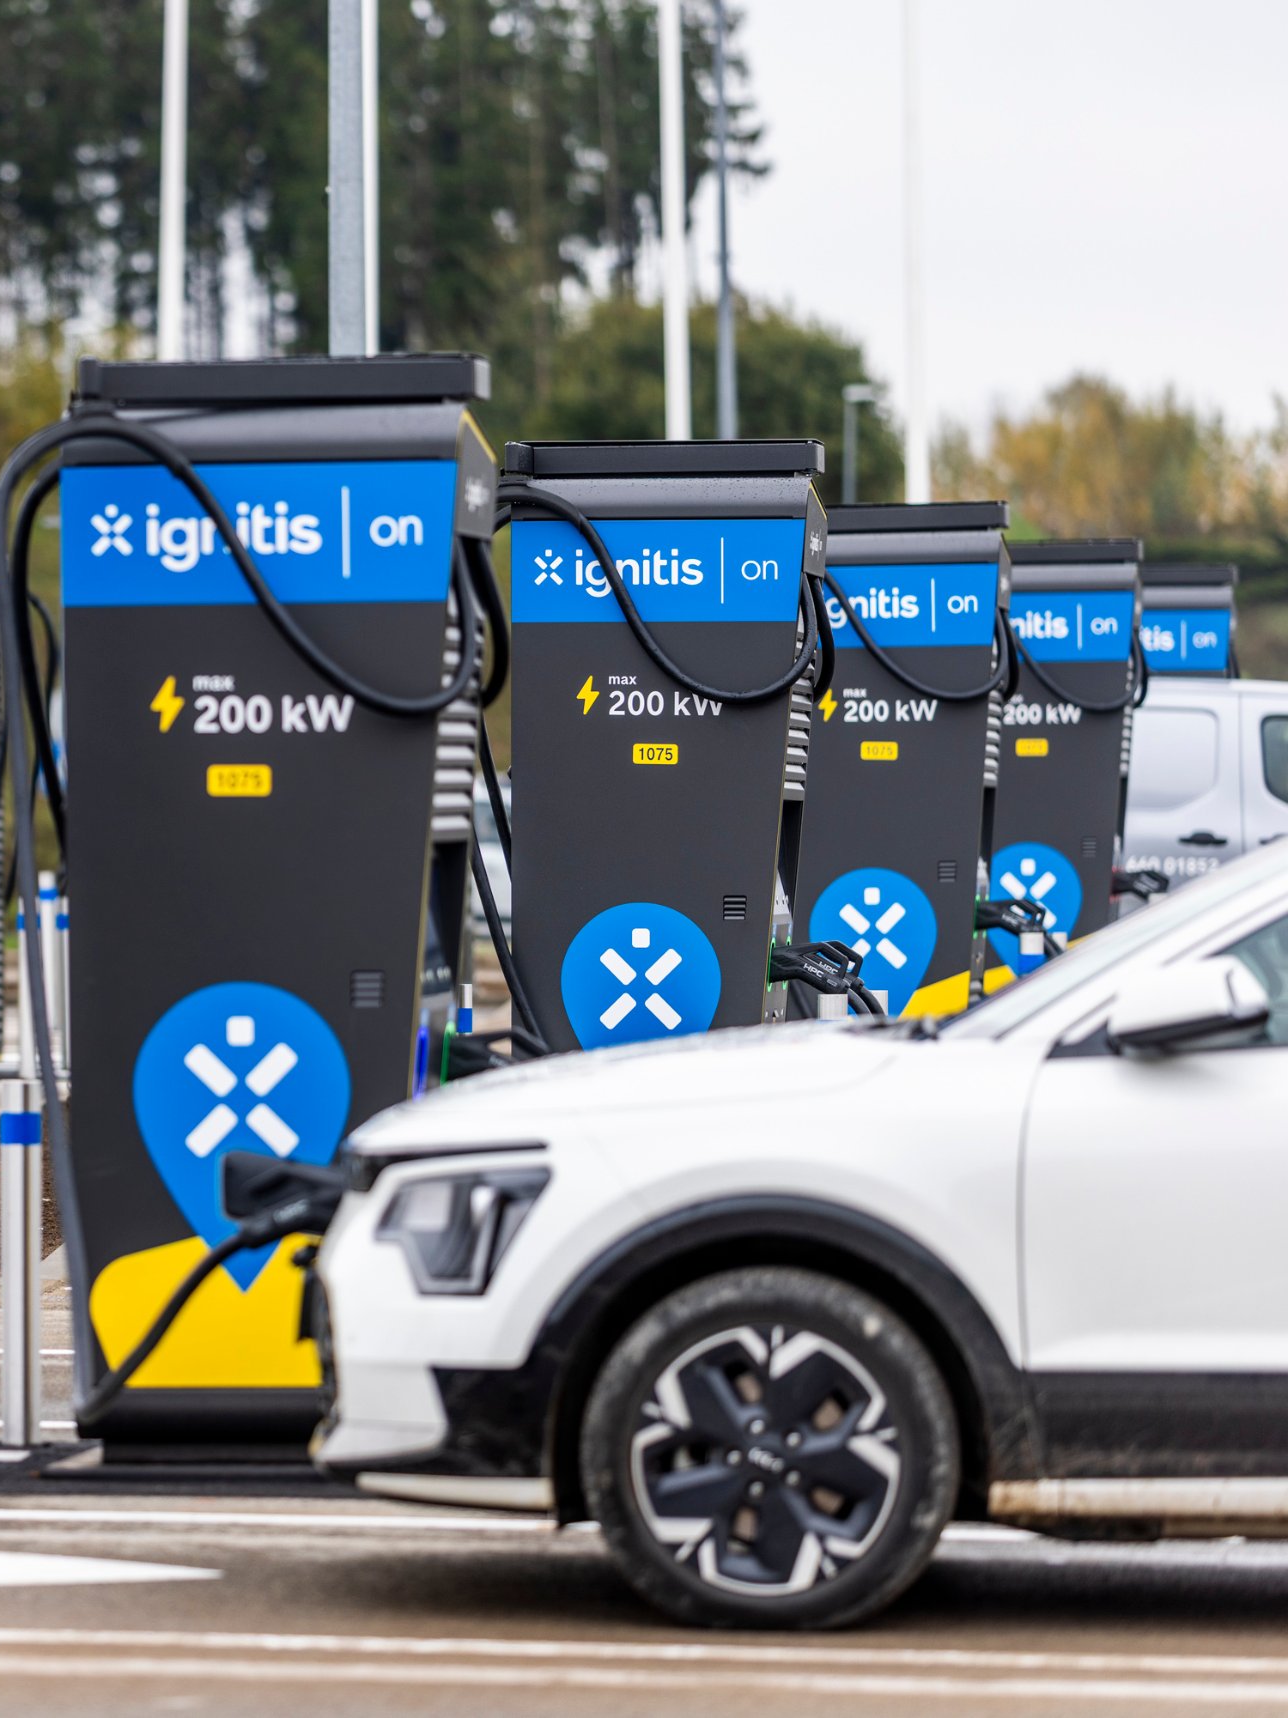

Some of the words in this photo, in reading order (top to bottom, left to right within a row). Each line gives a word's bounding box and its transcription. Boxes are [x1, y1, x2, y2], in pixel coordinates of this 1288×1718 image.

[370, 516, 422, 546] on
[576, 549, 703, 597] ignitis
[742, 561, 778, 580] on
[825, 588, 919, 628] gnitis
[948, 596, 978, 613] on
[1091, 618, 1117, 634] on
[193, 676, 234, 691] max
[609, 676, 636, 685] max
[194, 695, 272, 733] 200
[282, 695, 353, 732] kW
[609, 691, 664, 716] 200
[674, 692, 722, 716] kW
[844, 700, 889, 722] 200
[896, 700, 937, 721] kW
[1003, 703, 1042, 725] 200
[1046, 704, 1081, 724] kW
[638, 748, 673, 761] 1075
[803, 963, 824, 978] HPC
